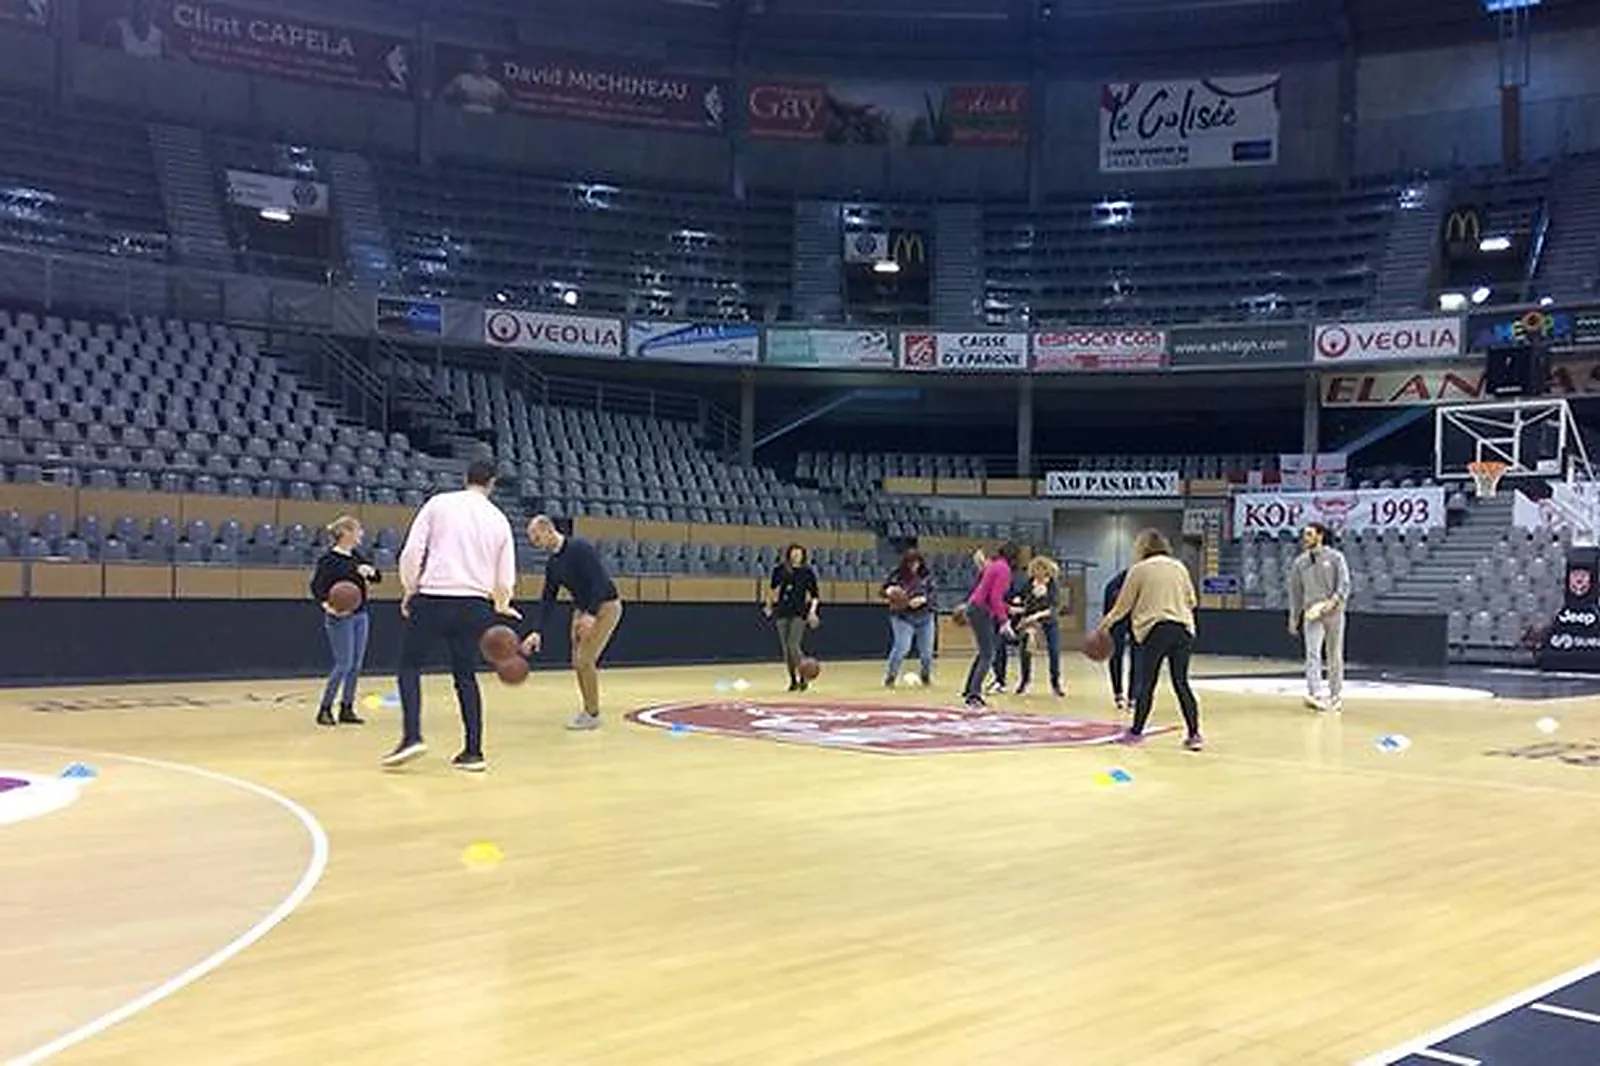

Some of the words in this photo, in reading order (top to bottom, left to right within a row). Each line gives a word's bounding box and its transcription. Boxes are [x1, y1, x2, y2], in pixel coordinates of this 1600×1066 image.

[172, 4, 241, 37] Clint
[250, 20, 355, 57] CAPELA
[504, 62, 562, 86] David
[567, 69, 687, 101] MICHINEAU
[750, 85, 824, 130] Gay
[526, 322, 619, 347] VEOLIA
[959, 335, 1008, 348] CAISSE
[1356, 329, 1458, 351] VEOLIA
[1325, 371, 1488, 403] ELAN
[1370, 498, 1430, 526] 1993
[1558, 608, 1596, 626] Jeep
